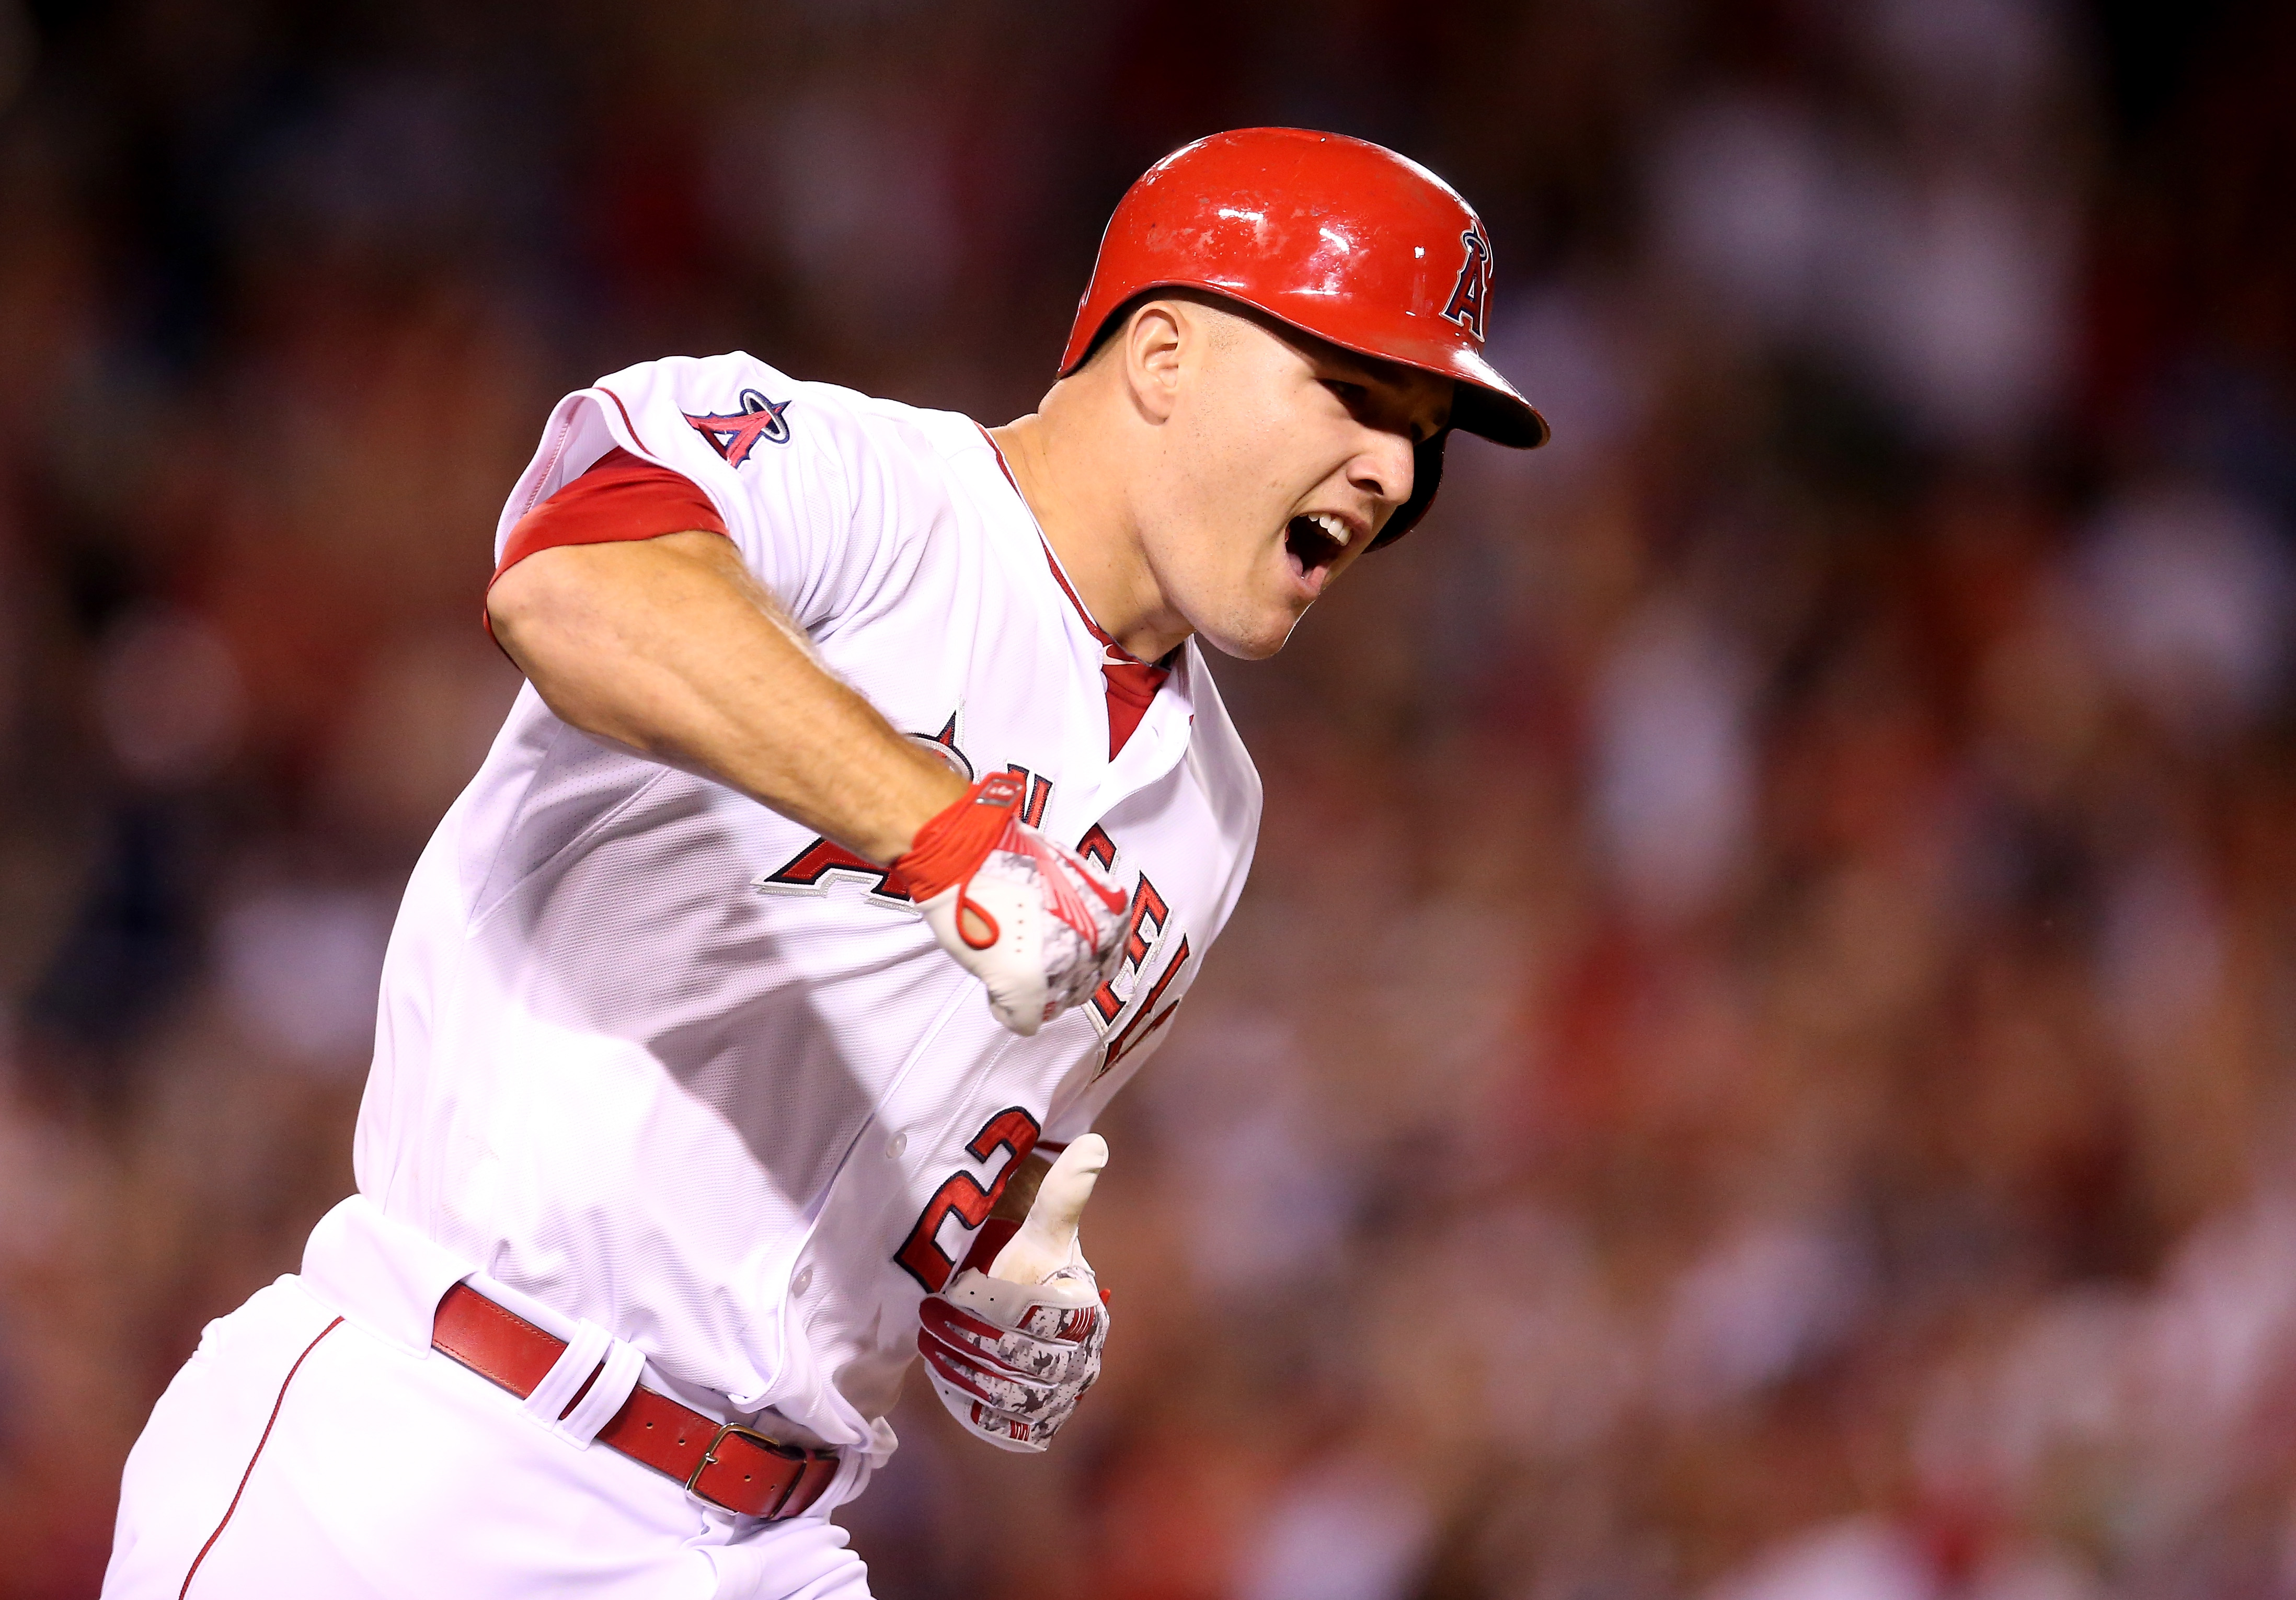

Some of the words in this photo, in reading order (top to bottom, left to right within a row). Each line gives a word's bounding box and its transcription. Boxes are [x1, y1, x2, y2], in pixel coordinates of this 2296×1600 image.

[1439, 219, 1490, 342] A
[680, 388, 792, 470] A
[893, 1105, 1041, 1294] 2
